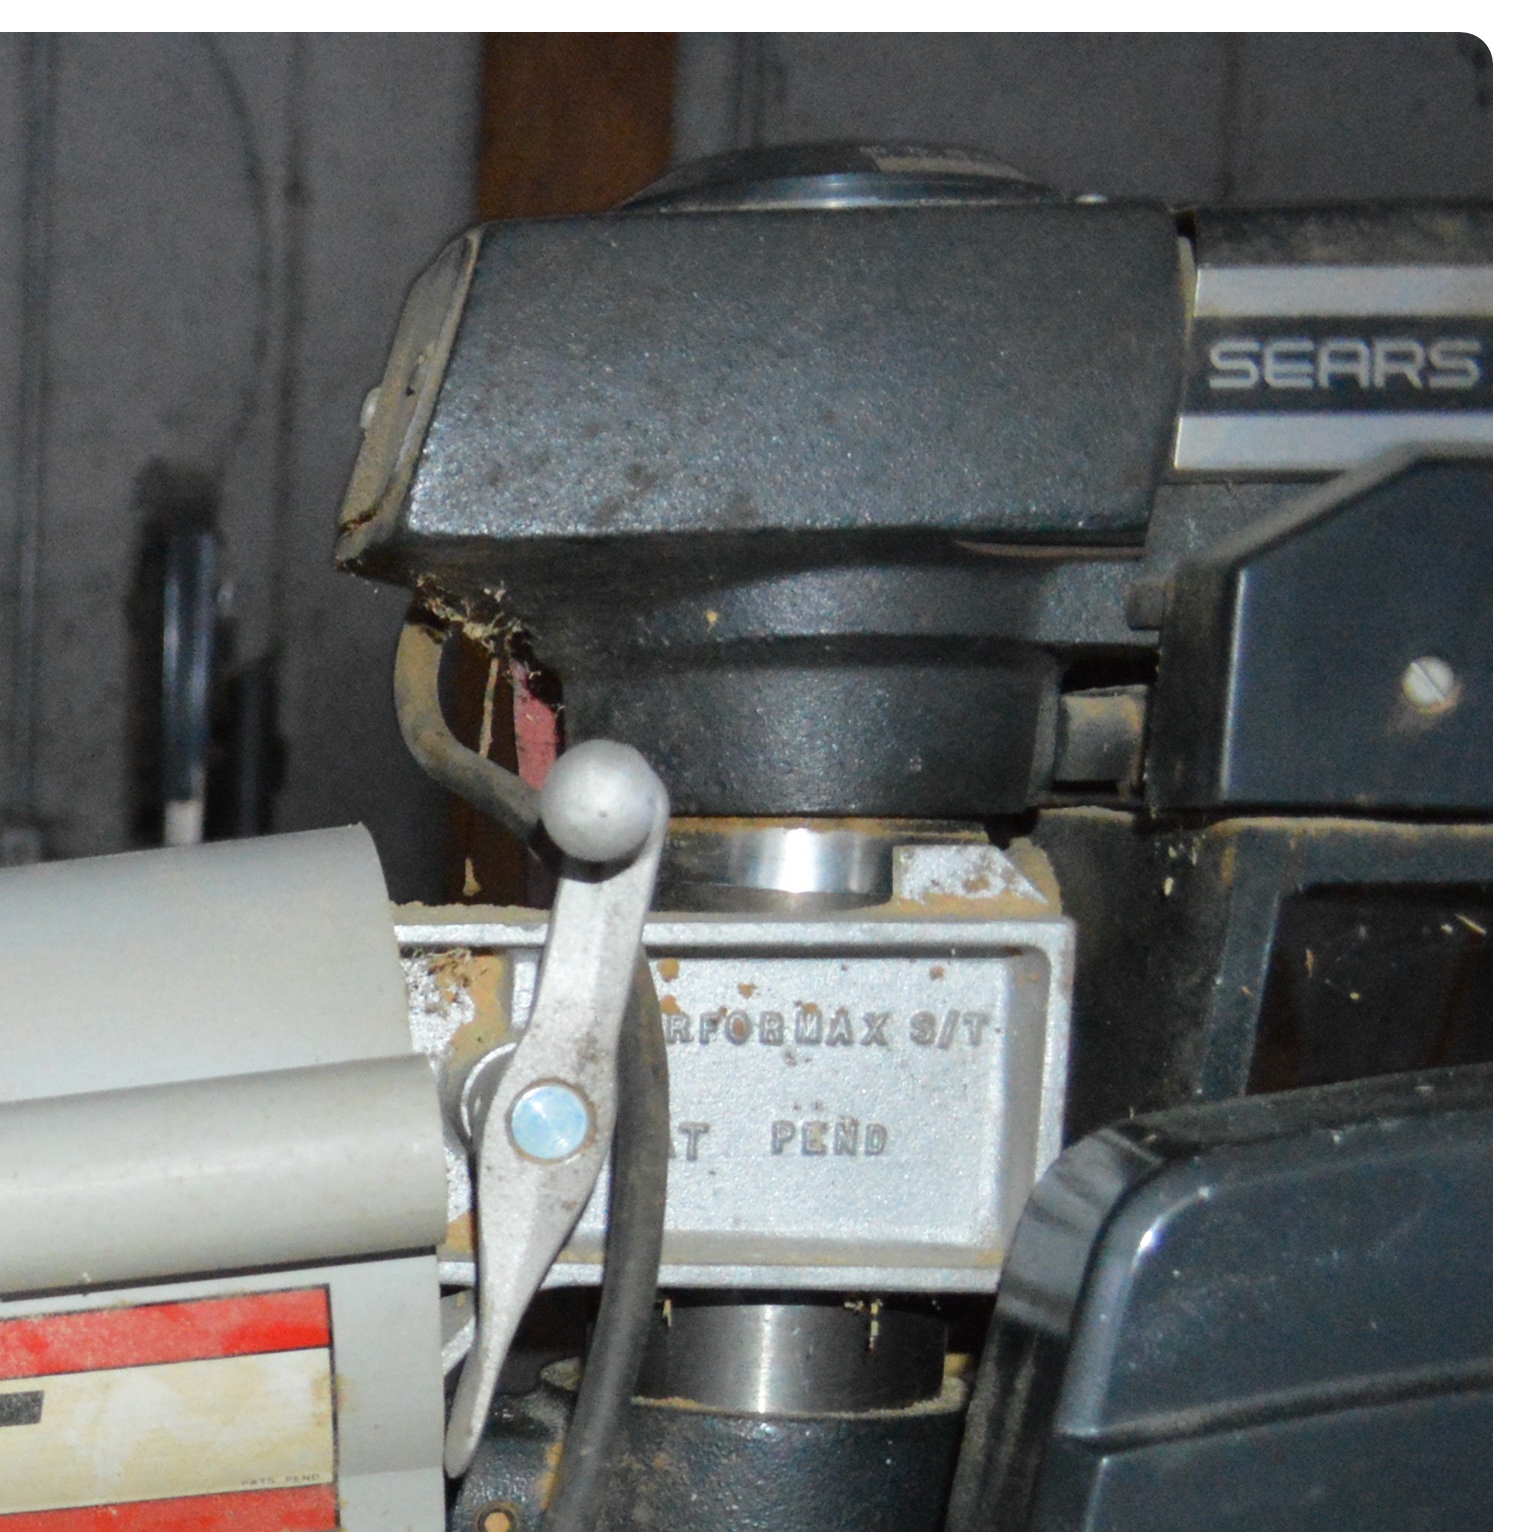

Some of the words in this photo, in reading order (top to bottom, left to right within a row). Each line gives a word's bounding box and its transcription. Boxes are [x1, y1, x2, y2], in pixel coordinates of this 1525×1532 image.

[1209, 338, 1482, 389] SEARS
[664, 1009, 890, 1047] RFORMAX
[910, 1009, 990, 1049] S/T
[770, 1118, 888, 1157] PEND
